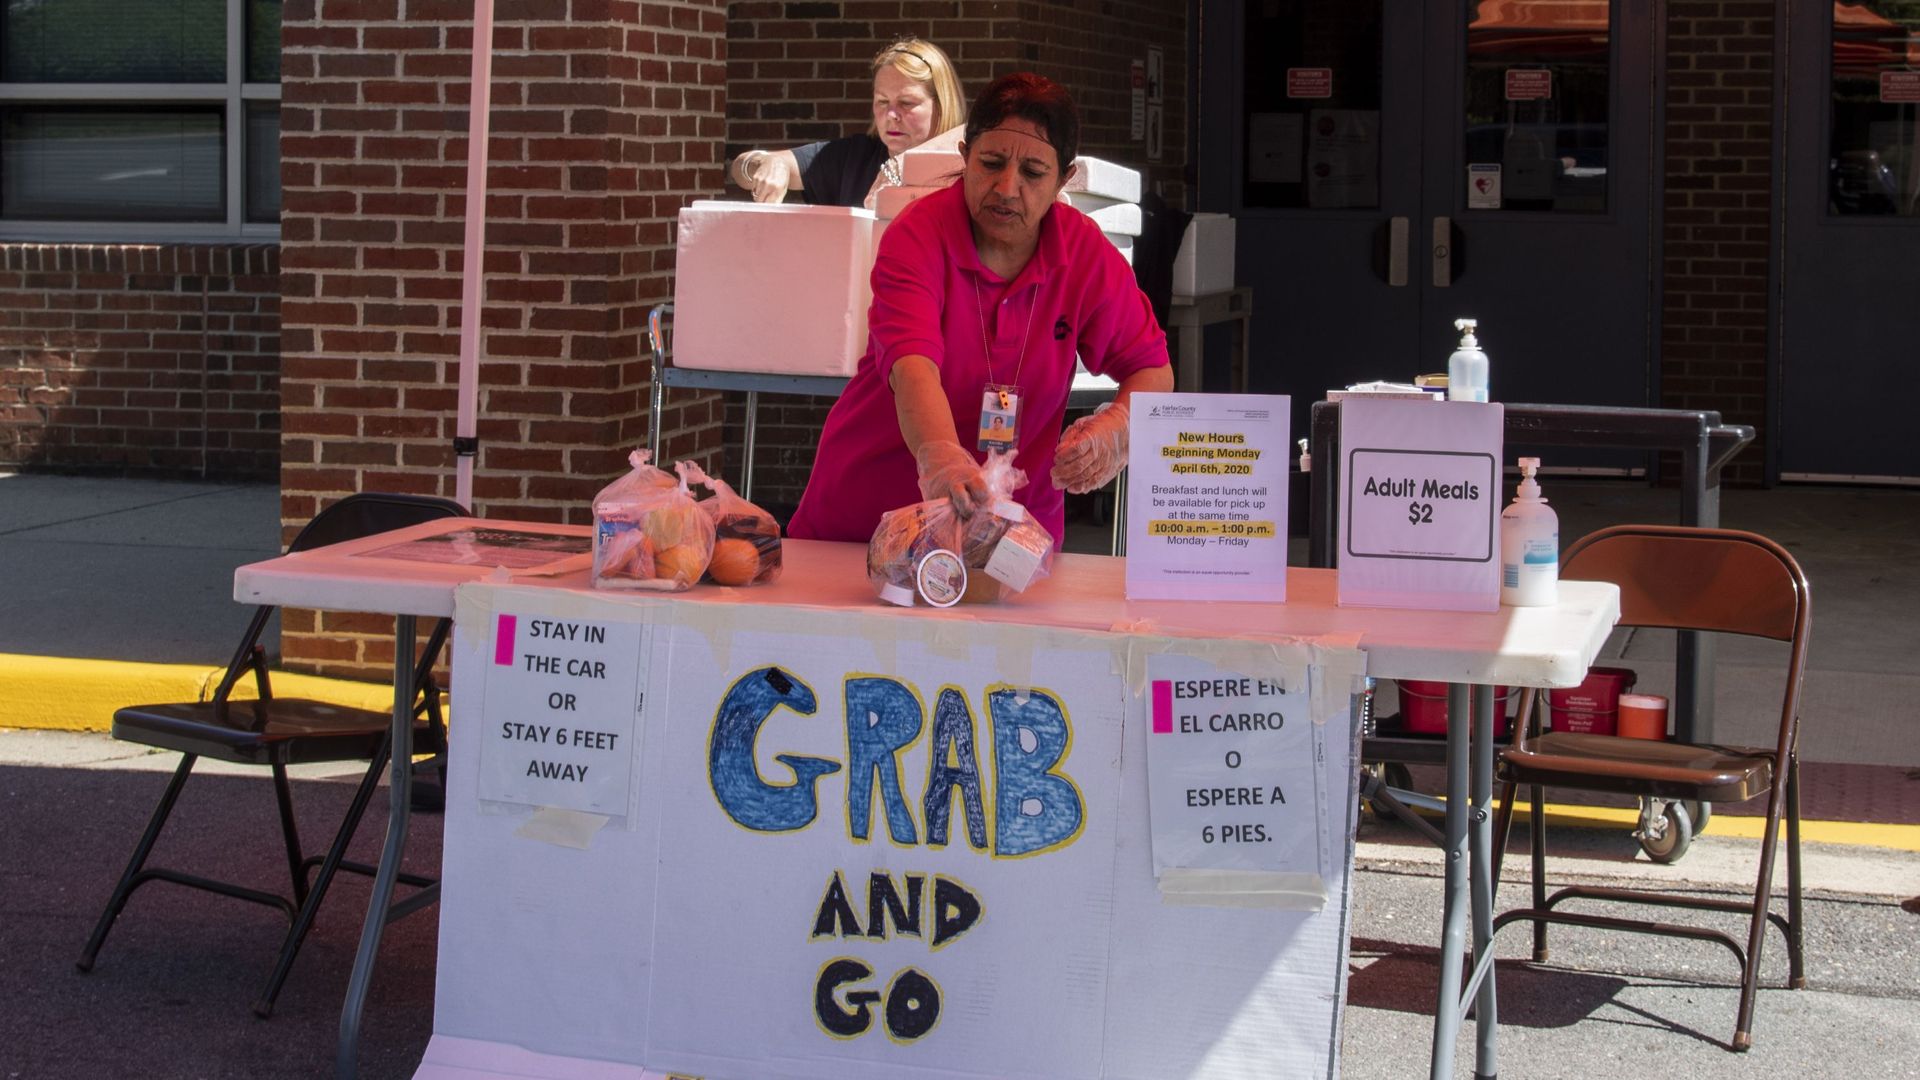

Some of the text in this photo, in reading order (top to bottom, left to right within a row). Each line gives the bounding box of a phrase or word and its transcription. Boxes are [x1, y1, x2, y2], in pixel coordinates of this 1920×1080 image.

[1179, 432, 1244, 443] New Hours
[1162, 448, 1261, 460] Beginning Monday
[1172, 464, 1250, 475] April 6th, 2020
[1151, 485, 1267, 496] Breakfast and lunch will
[1364, 476, 1479, 500] Adult Meals
[1153, 498, 1265, 511] be available for pick up
[1408, 501, 1433, 525] $2
[1167, 511, 1178, 520] at
[1180, 511, 1196, 520] the
[1228, 512, 1249, 520] time
[1154, 523, 1183, 533] 10:00
[1186, 525, 1209, 533] a.m.
[1222, 524, 1244, 533] 1:00
[1247, 526, 1270, 536] p.m.
[1167, 536, 1206, 547] Monday
[1219, 537, 1249, 548] Friday
[530, 620, 605, 644] STAY IN
[524, 654, 606, 679] THE CAR
[1175, 677, 1286, 699] ESPERE EN
[548, 692, 576, 711] OR
[1180, 712, 1284, 733] EL CARRO
[502, 722, 618, 750] STAY 6 FEET
[706, 663, 1086, 859] GRAB
[1225, 751, 1241, 768] O
[526, 760, 588, 782] AWAY
[1186, 786, 1286, 807] ESPERE A
[1202, 824, 1272, 844] 6 PIES.
[809, 869, 985, 952] AND
[815, 956, 944, 1045] GO
